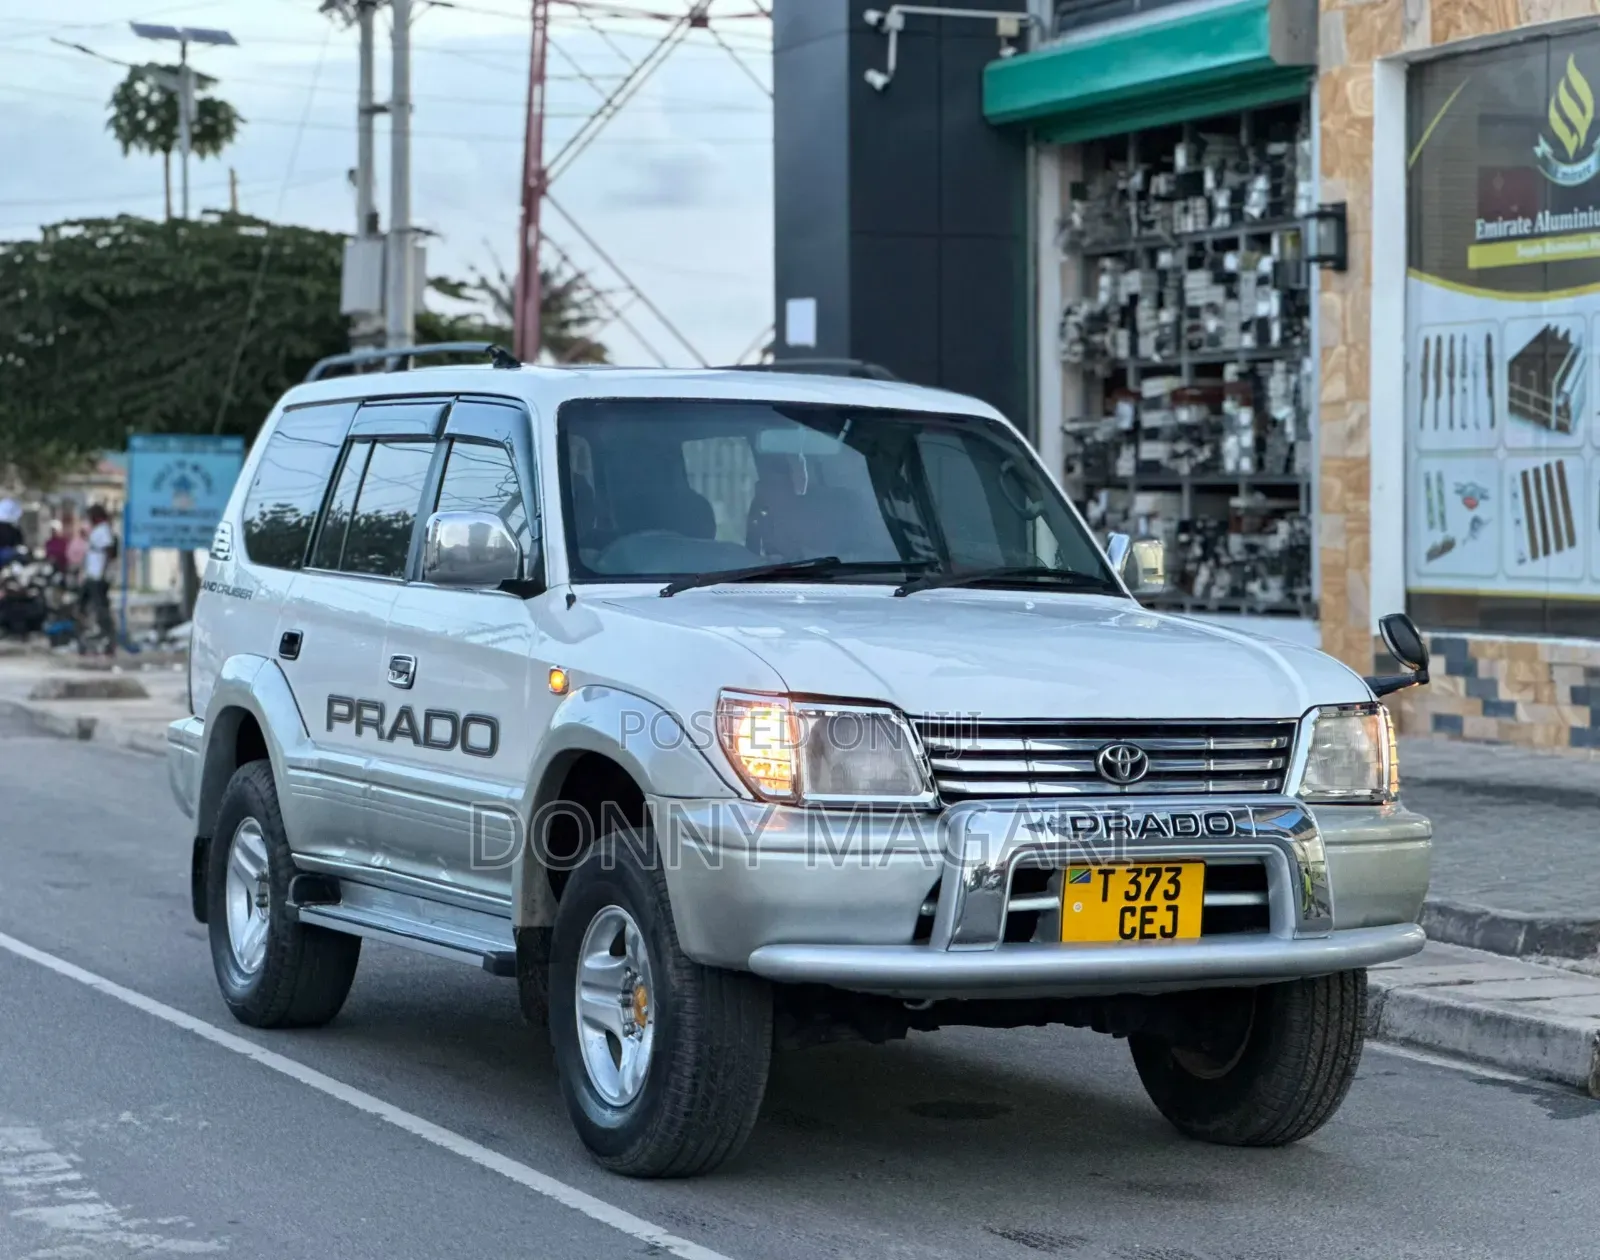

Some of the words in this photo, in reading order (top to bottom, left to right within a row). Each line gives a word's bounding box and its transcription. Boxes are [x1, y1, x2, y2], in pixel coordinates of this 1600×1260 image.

[1475, 215, 1532, 240] Emirate
[217, 583, 253, 600] CRUISER
[326, 694, 500, 758] PRADO
[1069, 812, 1236, 840] PRADO
[1098, 869, 1115, 903] T
[1124, 867, 1182, 902] 373
[1119, 904, 1179, 940] CEJ
